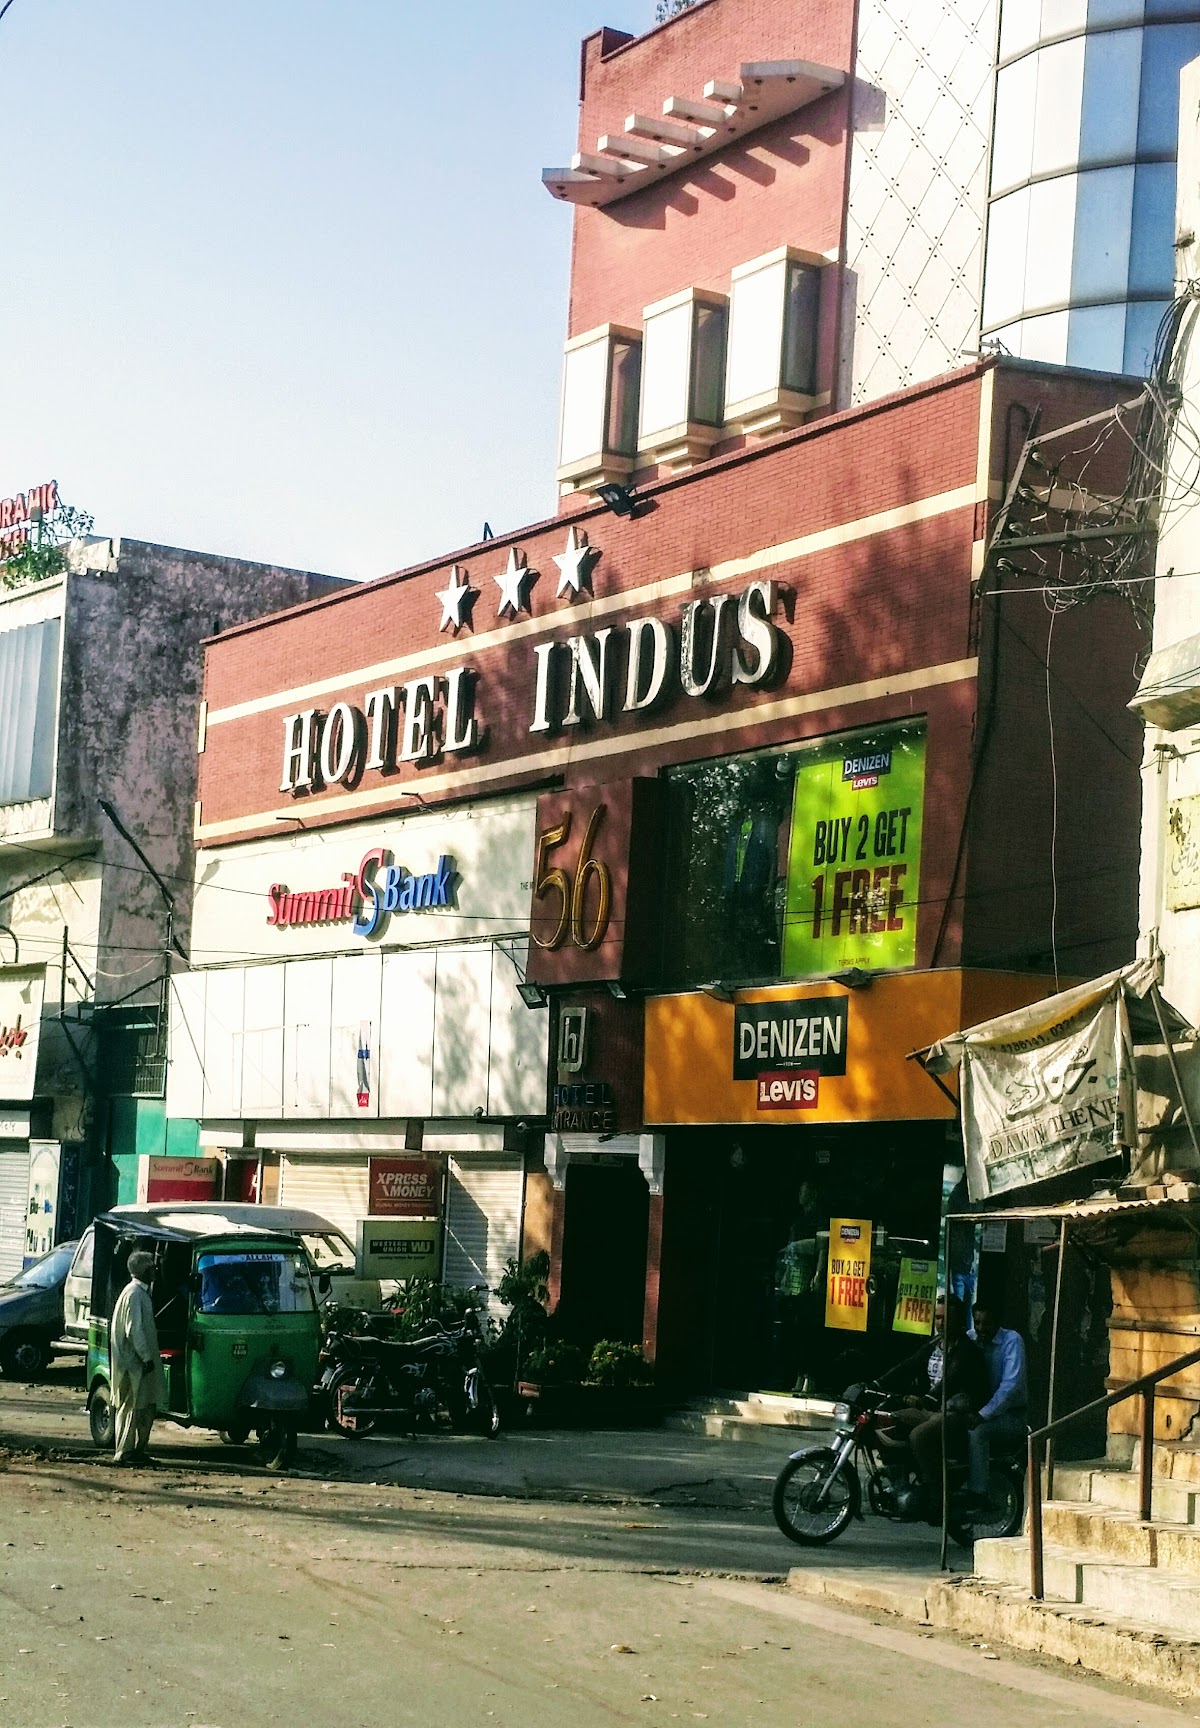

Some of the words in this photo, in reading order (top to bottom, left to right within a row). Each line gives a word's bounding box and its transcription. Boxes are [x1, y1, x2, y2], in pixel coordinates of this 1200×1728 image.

[0, 480, 57, 528] RAMIC
[280, 667, 477, 793] HOTEL
[529, 580, 778, 732] INDUS
[844, 753, 890, 775] DENIZEN
[813, 816, 852, 866] BUY
[855, 814, 869, 861] 2
[873, 807, 911, 857] GET
[266, 872, 357, 925] Summit
[383, 854, 458, 911] Bank
[532, 804, 610, 951] 56
[811, 874, 824, 939] 1
[831, 864, 907, 936] FREE
[740, 1015, 841, 1060] DENIZEN
[553, 1084, 611, 1105] HOTEL
[990, 1126, 1047, 1159] DAWN
[1049, 1108, 1088, 1134] THE
[194, 1165, 213, 1174] Bank
[376, 1173, 428, 1185] XPRESS
[389, 1186, 435, 1198] MONEY
[832, 1259, 844, 1275] BUY
[846, 1260, 851, 1276] 2
[853, 1261, 865, 1277] GET
[831, 1277, 835, 1305] 1
[838, 1277, 865, 1307] FREE
[914, 1285, 919, 1298] 2
[904, 1298, 931, 1323] FREE
